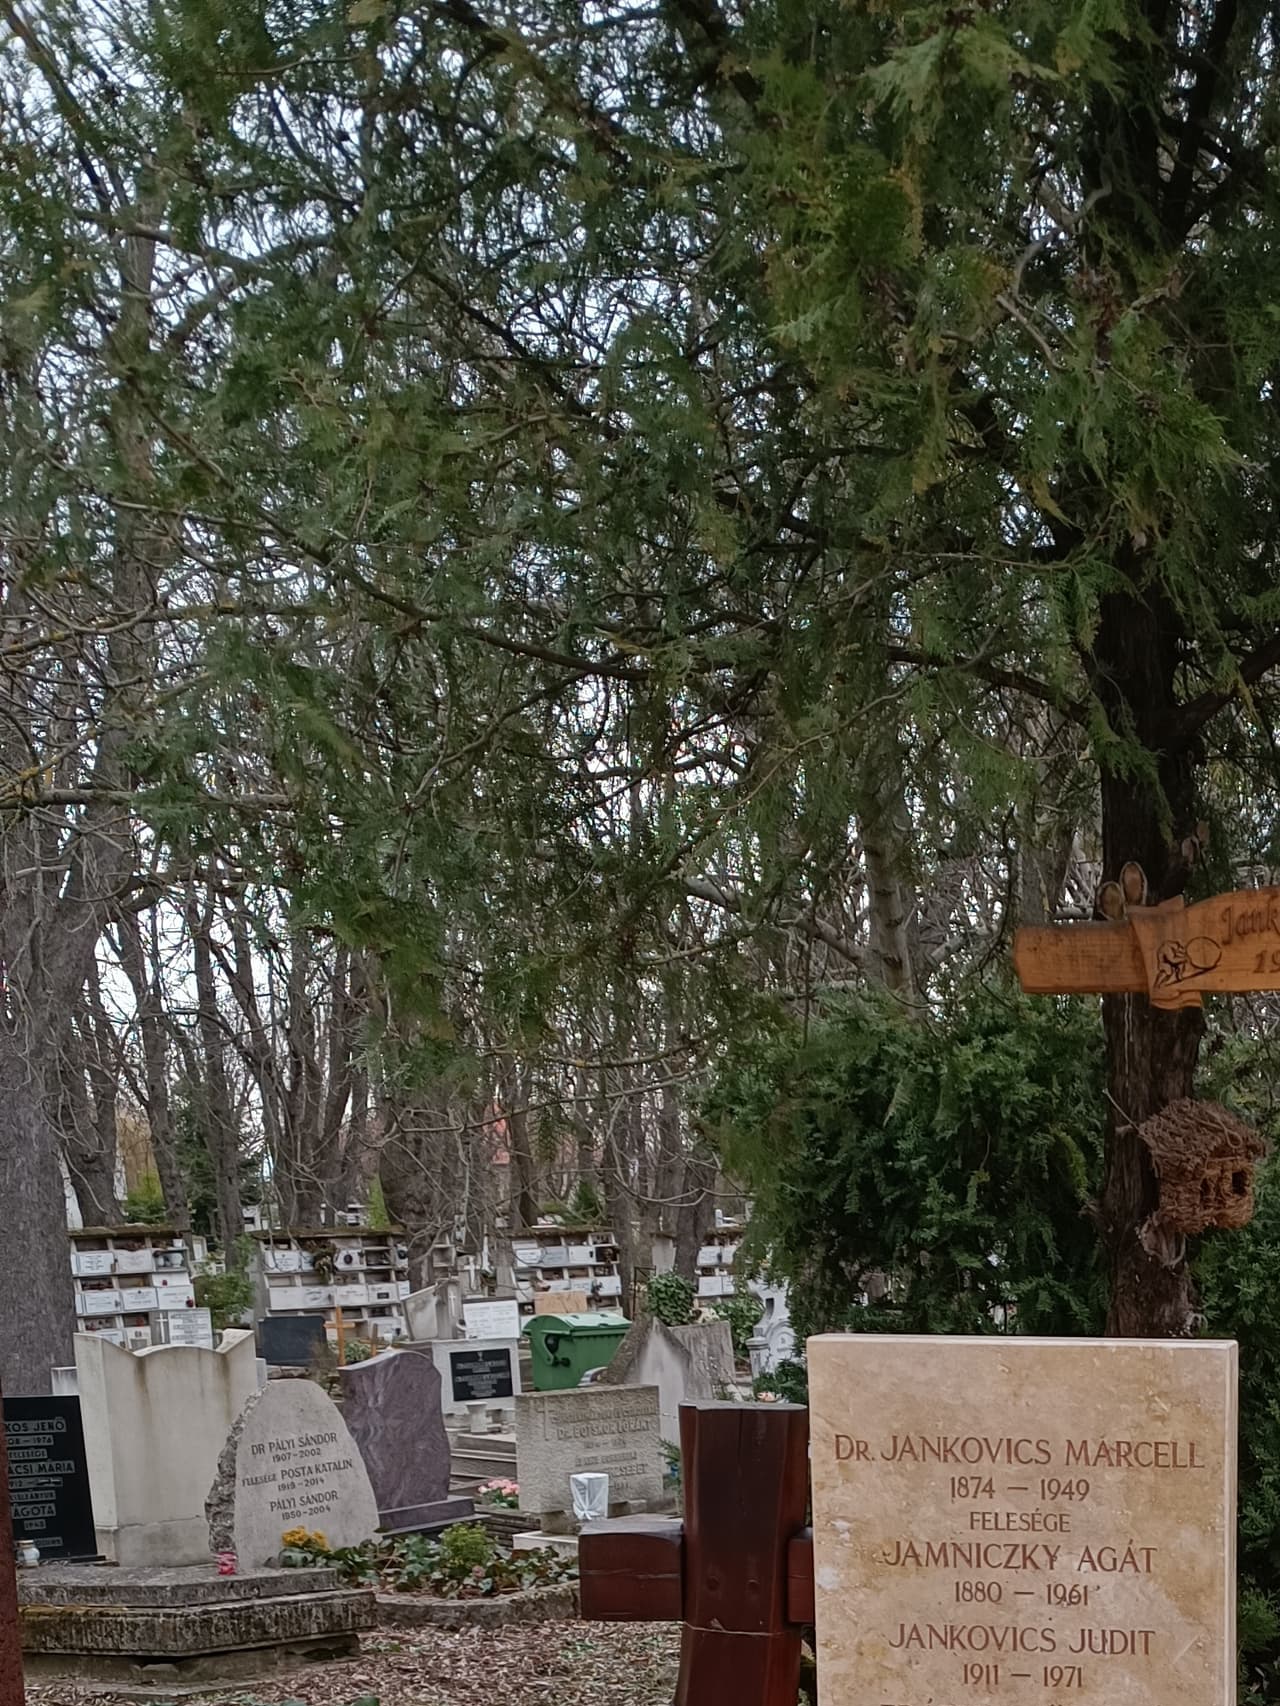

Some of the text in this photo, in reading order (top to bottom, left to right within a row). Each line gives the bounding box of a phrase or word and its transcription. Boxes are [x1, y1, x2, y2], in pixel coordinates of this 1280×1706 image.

[251, 1444, 265, 1457] DR
[298, 1432, 338, 1449] SÁNDOR
[880, 1435, 1052, 1464] JANKOVICS
[1065, 1439, 1205, 1468] MARCELL
[281, 1465, 313, 1481] POSTA
[314, 1459, 353, 1475] KATALIN
[950, 1476, 995, 1499] 1874
[1040, 1478, 1090, 1501] 1949
[970, 1508, 1071, 1532] FELESÉGE
[885, 1538, 1158, 1573] JAMNICZKY AGÁT
[955, 1581, 1003, 1603] 1880
[1047, 1584, 1088, 1606] 1961
[889, 1623, 1156, 1656] JANKOVICS JUDIT
[964, 1663, 999, 1686] 1911
[1044, 1666, 1083, 1688] 1971
